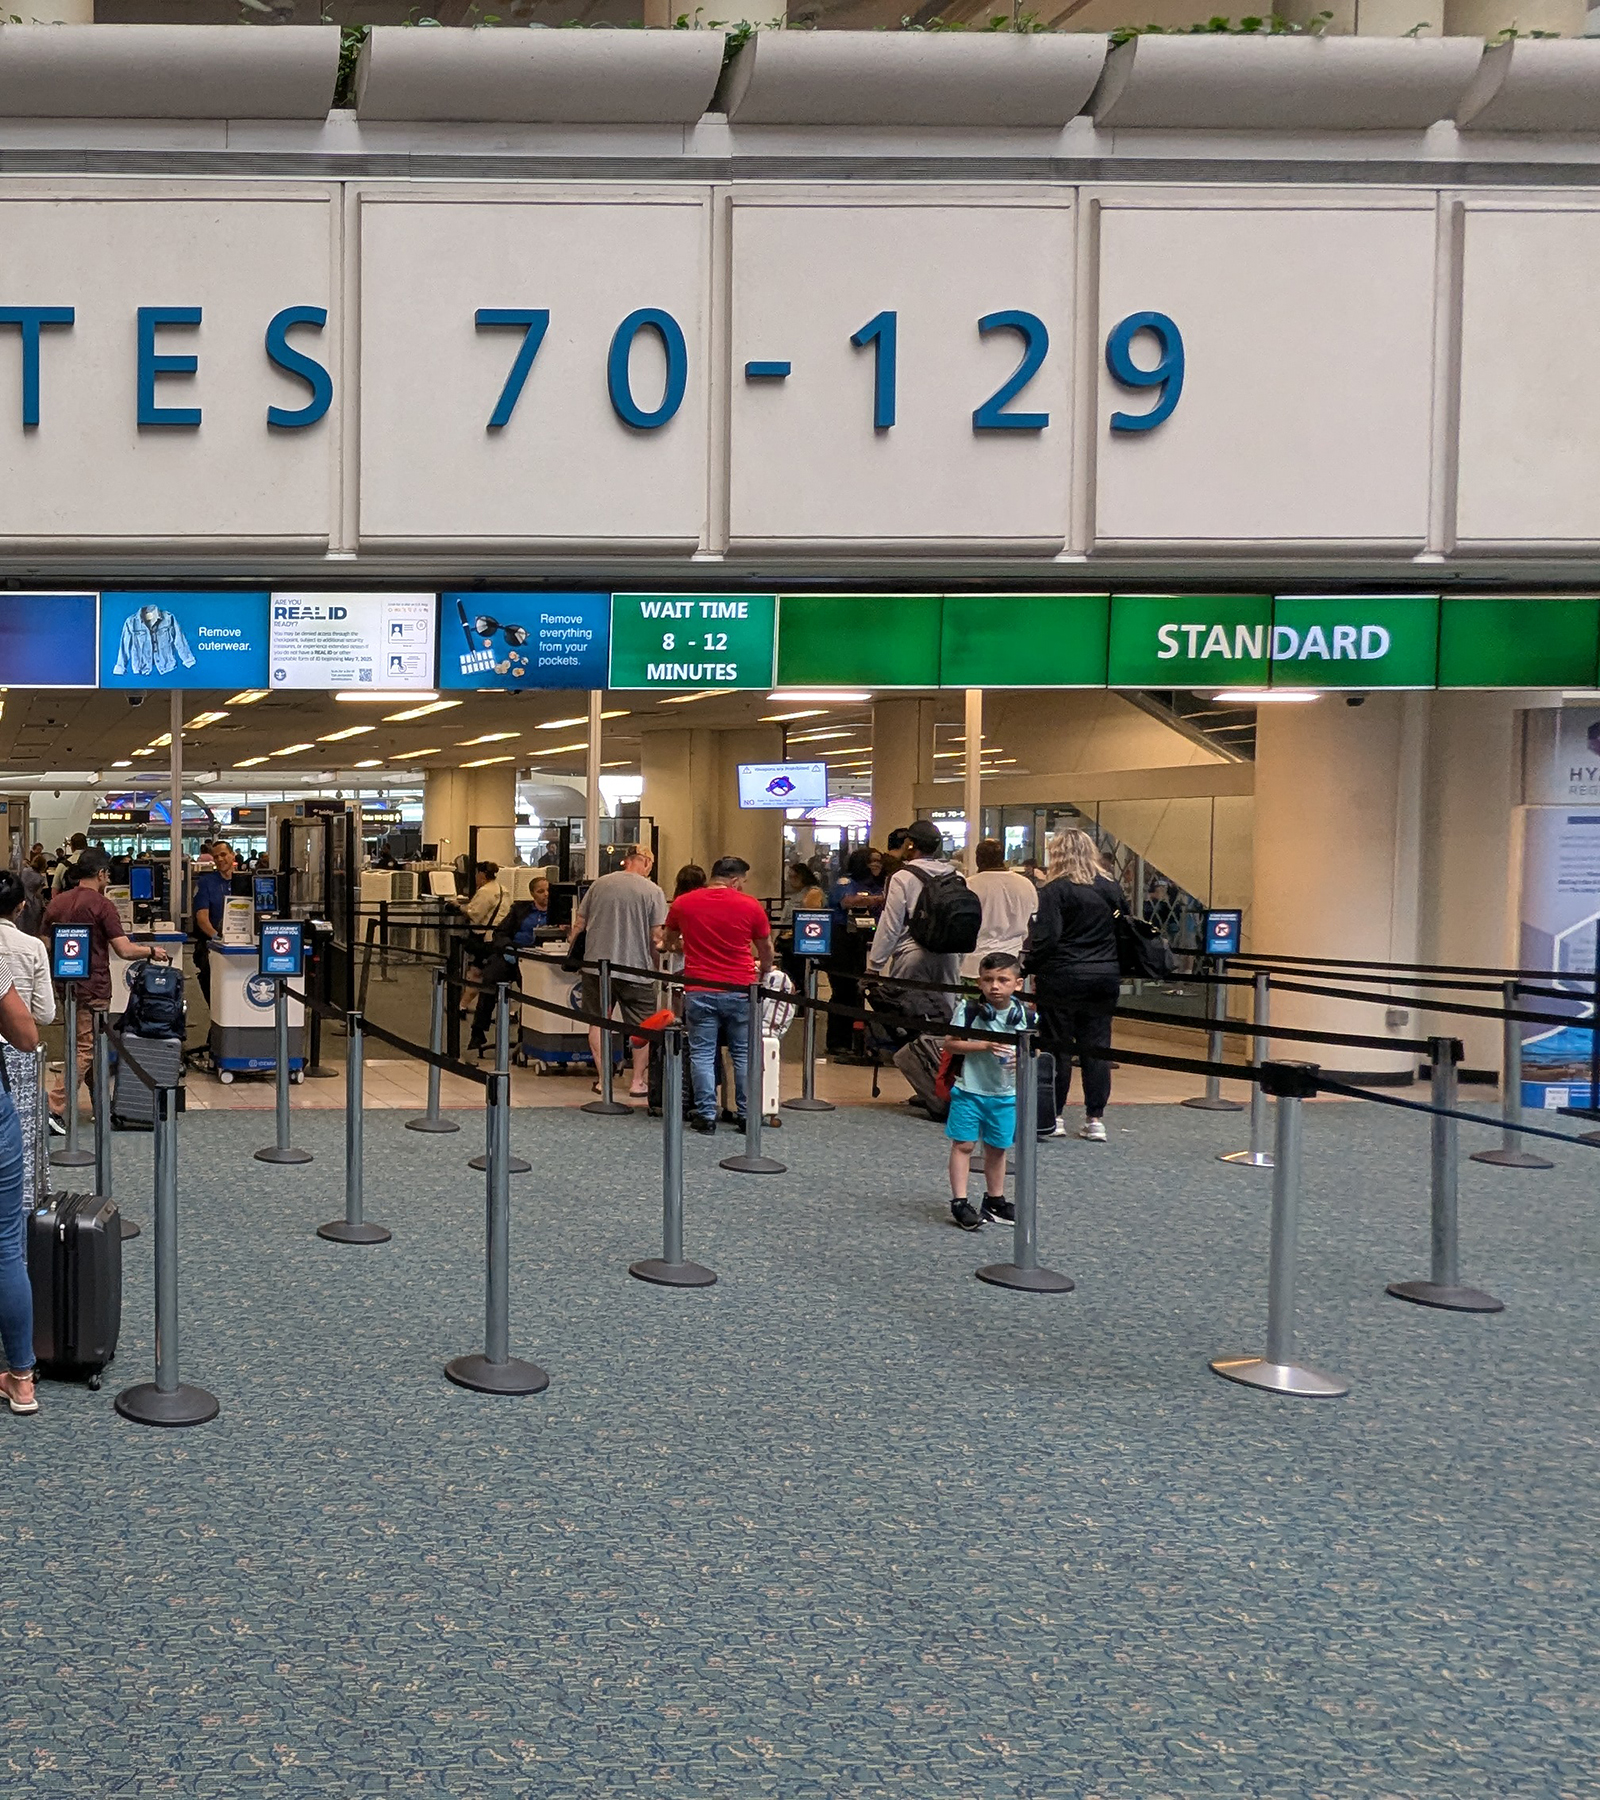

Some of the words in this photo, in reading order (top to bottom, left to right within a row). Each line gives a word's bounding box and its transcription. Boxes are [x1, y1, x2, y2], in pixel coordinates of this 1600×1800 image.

[477, 309, 1184, 429] 70-129
[274, 607, 326, 620] REAL
[328, 607, 347, 620] ID
[640, 602, 694, 618] WAIT
[699, 602, 748, 618] TIME
[541, 614, 582, 624] Remove
[199, 627, 241, 637] Remove
[539, 629, 592, 640] everything
[199, 642, 251, 651] outerwear.
[539, 642, 562, 651] from
[565, 643, 587, 652] your
[662, 633, 675, 650] 8
[704, 633, 727, 650] 12
[1157, 623, 1390, 660] STANDARD
[539, 656, 581, 667] pockets.
[647, 663, 737, 680] MINUTES
[1570, 767, 1600, 782] HY
[1569, 786, 1600, 795] REG
